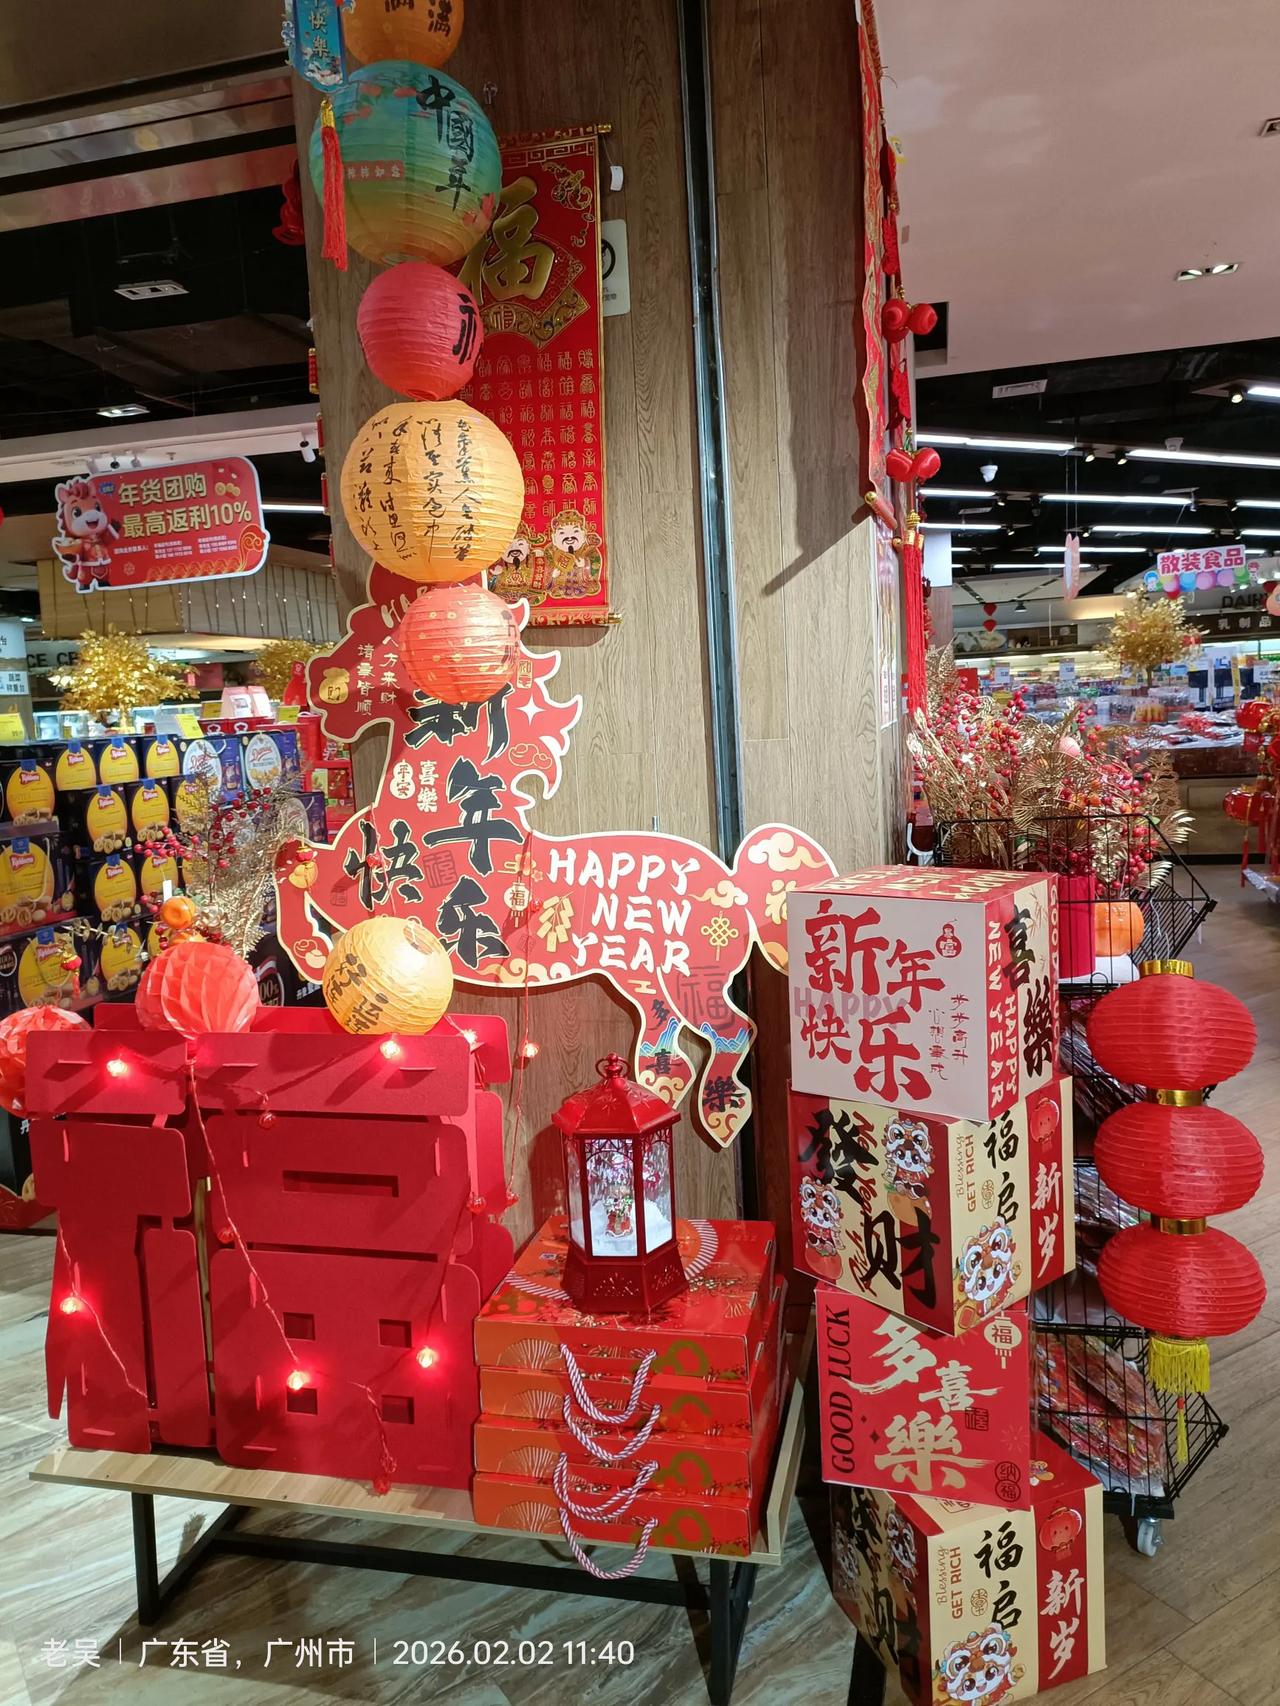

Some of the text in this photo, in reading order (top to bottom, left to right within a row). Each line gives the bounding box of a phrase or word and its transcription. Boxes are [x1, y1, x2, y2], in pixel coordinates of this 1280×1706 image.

[416, 74, 475, 212] 中國年
[118, 473, 207, 507] 年货团购
[122, 500, 252, 539] 最高返利10%
[1160, 547, 1244, 575] 散装食品
[393, 763, 415, 798] 平安
[416, 760, 440, 813] 喜樂
[509, 889, 526, 907] 福
[546, 848, 700, 896] HAPPY
[591, 893, 691, 937] NEW
[572, 932, 690, 977] YEAR
[805, 898, 946, 1012] 新年
[928, 1007, 949, 1081] 心想事成
[949, 992, 970, 1065] 步步高升
[988, 920, 1004, 1109] NEW YEAR
[1004, 994, 1018, 1096] HAPPY
[800, 1002, 933, 1102] 快乐
[955, 1133, 965, 1200] Blessing
[966, 1133, 976, 1213] GET RICH
[983, 1110, 1020, 1225] 福启
[1031, 1161, 1062, 1279] 新岁
[991, 1324, 1014, 1346] 福
[825, 1303, 856, 1474] GOOD LUCK
[936, 1544, 949, 1606] Blessing
[949, 1545, 964, 1620] GET RICH
[973, 1520, 1024, 1631] 福启
[1040, 1567, 1085, 1680] 新岁
